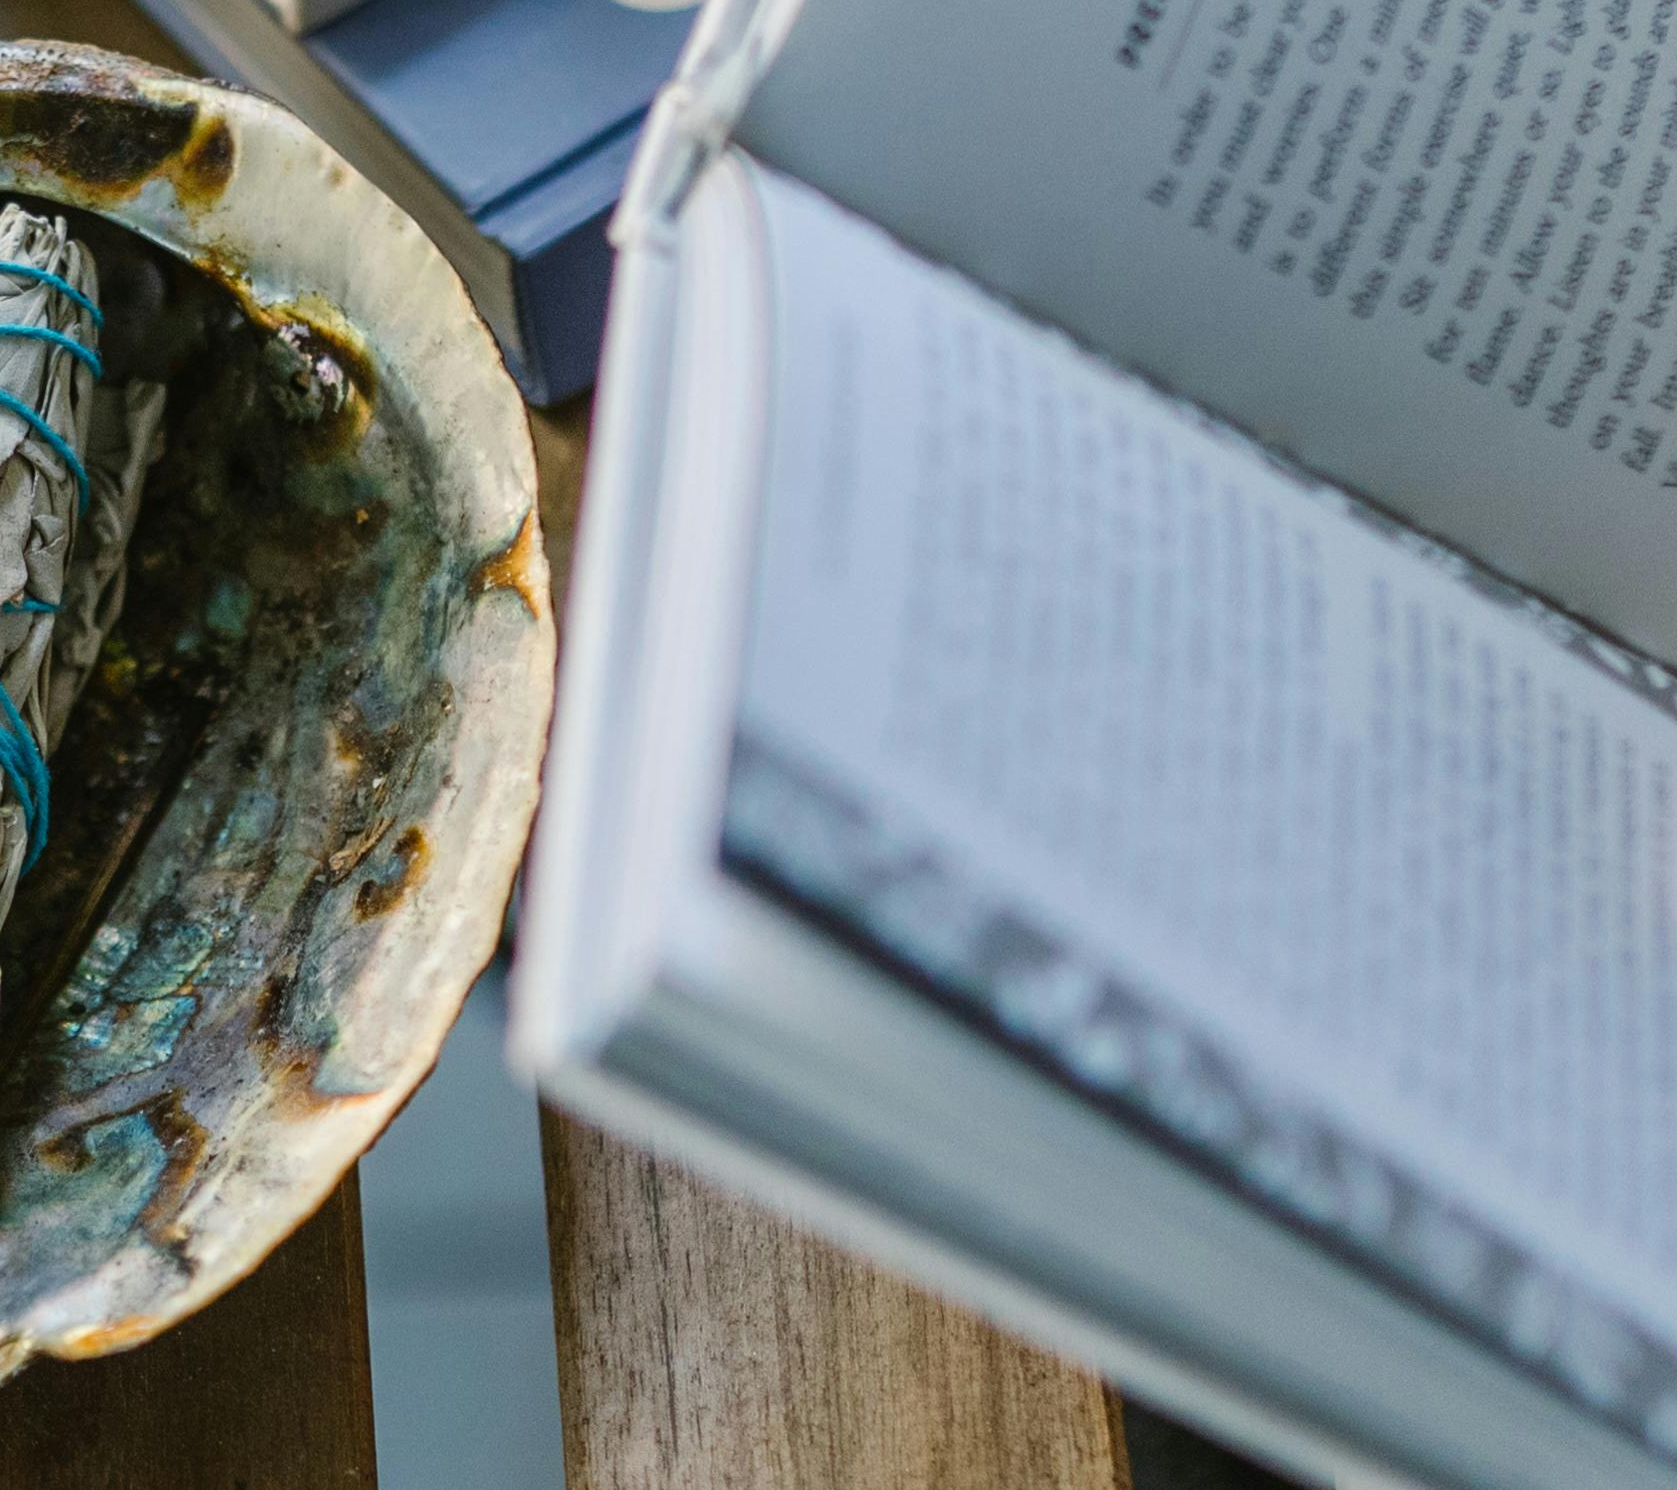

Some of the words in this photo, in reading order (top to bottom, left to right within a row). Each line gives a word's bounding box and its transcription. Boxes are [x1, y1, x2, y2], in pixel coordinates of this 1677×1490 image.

[1635, 154, 1672, 223] your
[1617, 225, 1649, 252] in
[1607, 257, 1636, 303] are
[1545, 308, 1617, 429] thoughts
[1588, 413, 1621, 451] on
[1609, 337, 1652, 408] your
[1621, 425, 1664, 474] fall.
